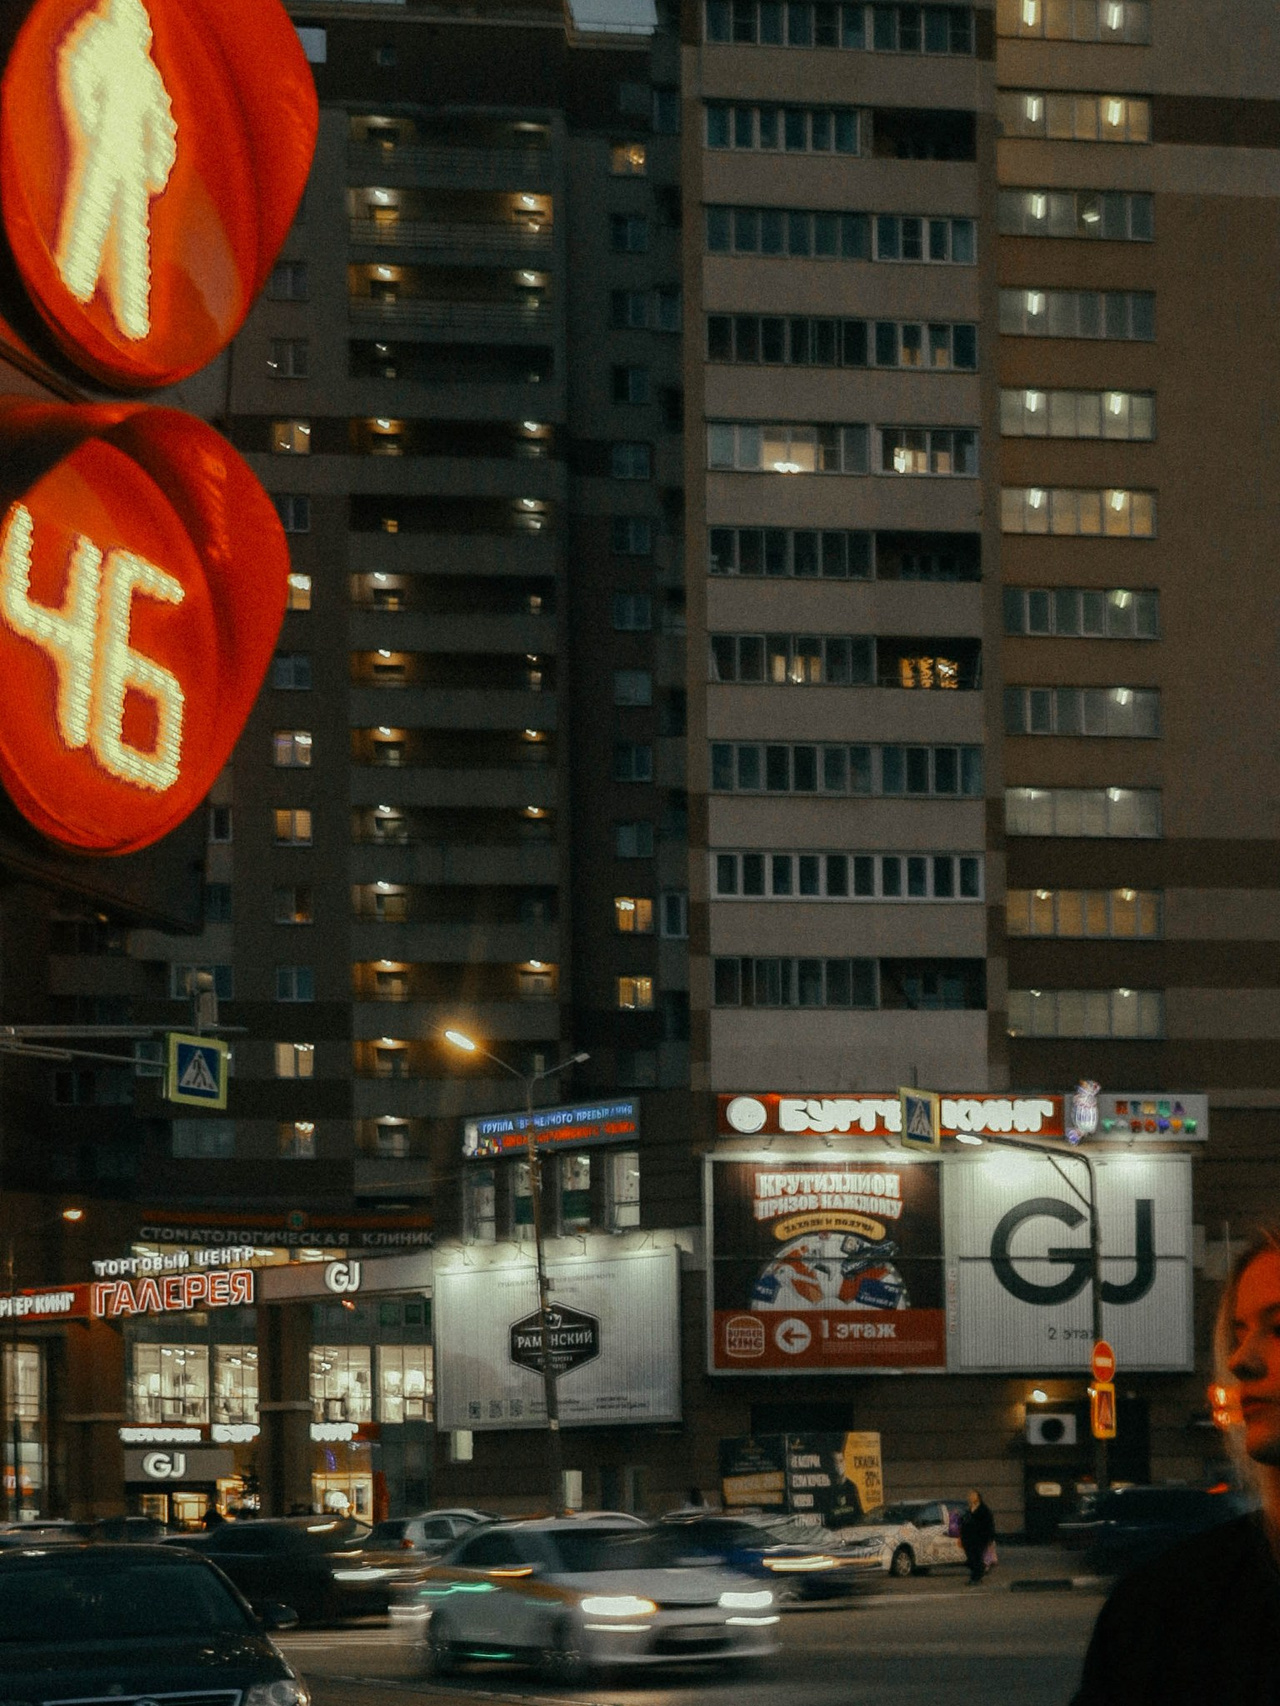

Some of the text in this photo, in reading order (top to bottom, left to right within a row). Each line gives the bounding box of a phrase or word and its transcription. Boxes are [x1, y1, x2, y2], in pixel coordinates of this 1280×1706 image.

[2, 502, 186, 792] 46
[482, 1119, 514, 1134] ГРУППА
[519, 1112, 573, 1130] ВРМЕННОГО
[779, 1099, 1054, 1132] БУРГЕ КИНГ
[755, 1172, 900, 1198] КРУТИЛЛИОН
[754, 1194, 902, 1220] ПРИЗОВ КАЖДОМУ
[138, 1226, 435, 1246] СТОМАТОЛОГИЧЕСКАЯ КЛИНИК
[92, 1246, 255, 1277] ТОРГОВЫЙ ЦЕНТР
[990, 1197, 1156, 1306] GJ
[325, 1261, 362, 1293] GJ
[35, 1292, 75, 1315] КИНГ
[91, 1269, 254, 1317] ГАЛЕРЕЯ
[517, 1329, 594, 1349] РАМНСКИЙ
[727, 1329, 764, 1338] BURGER
[822, 1319, 897, 1339] 1 этаж
[1047, 1327, 1057, 1340] 2
[727, 1338, 764, 1350] KING
[143, 1452, 187, 1478] GJ
